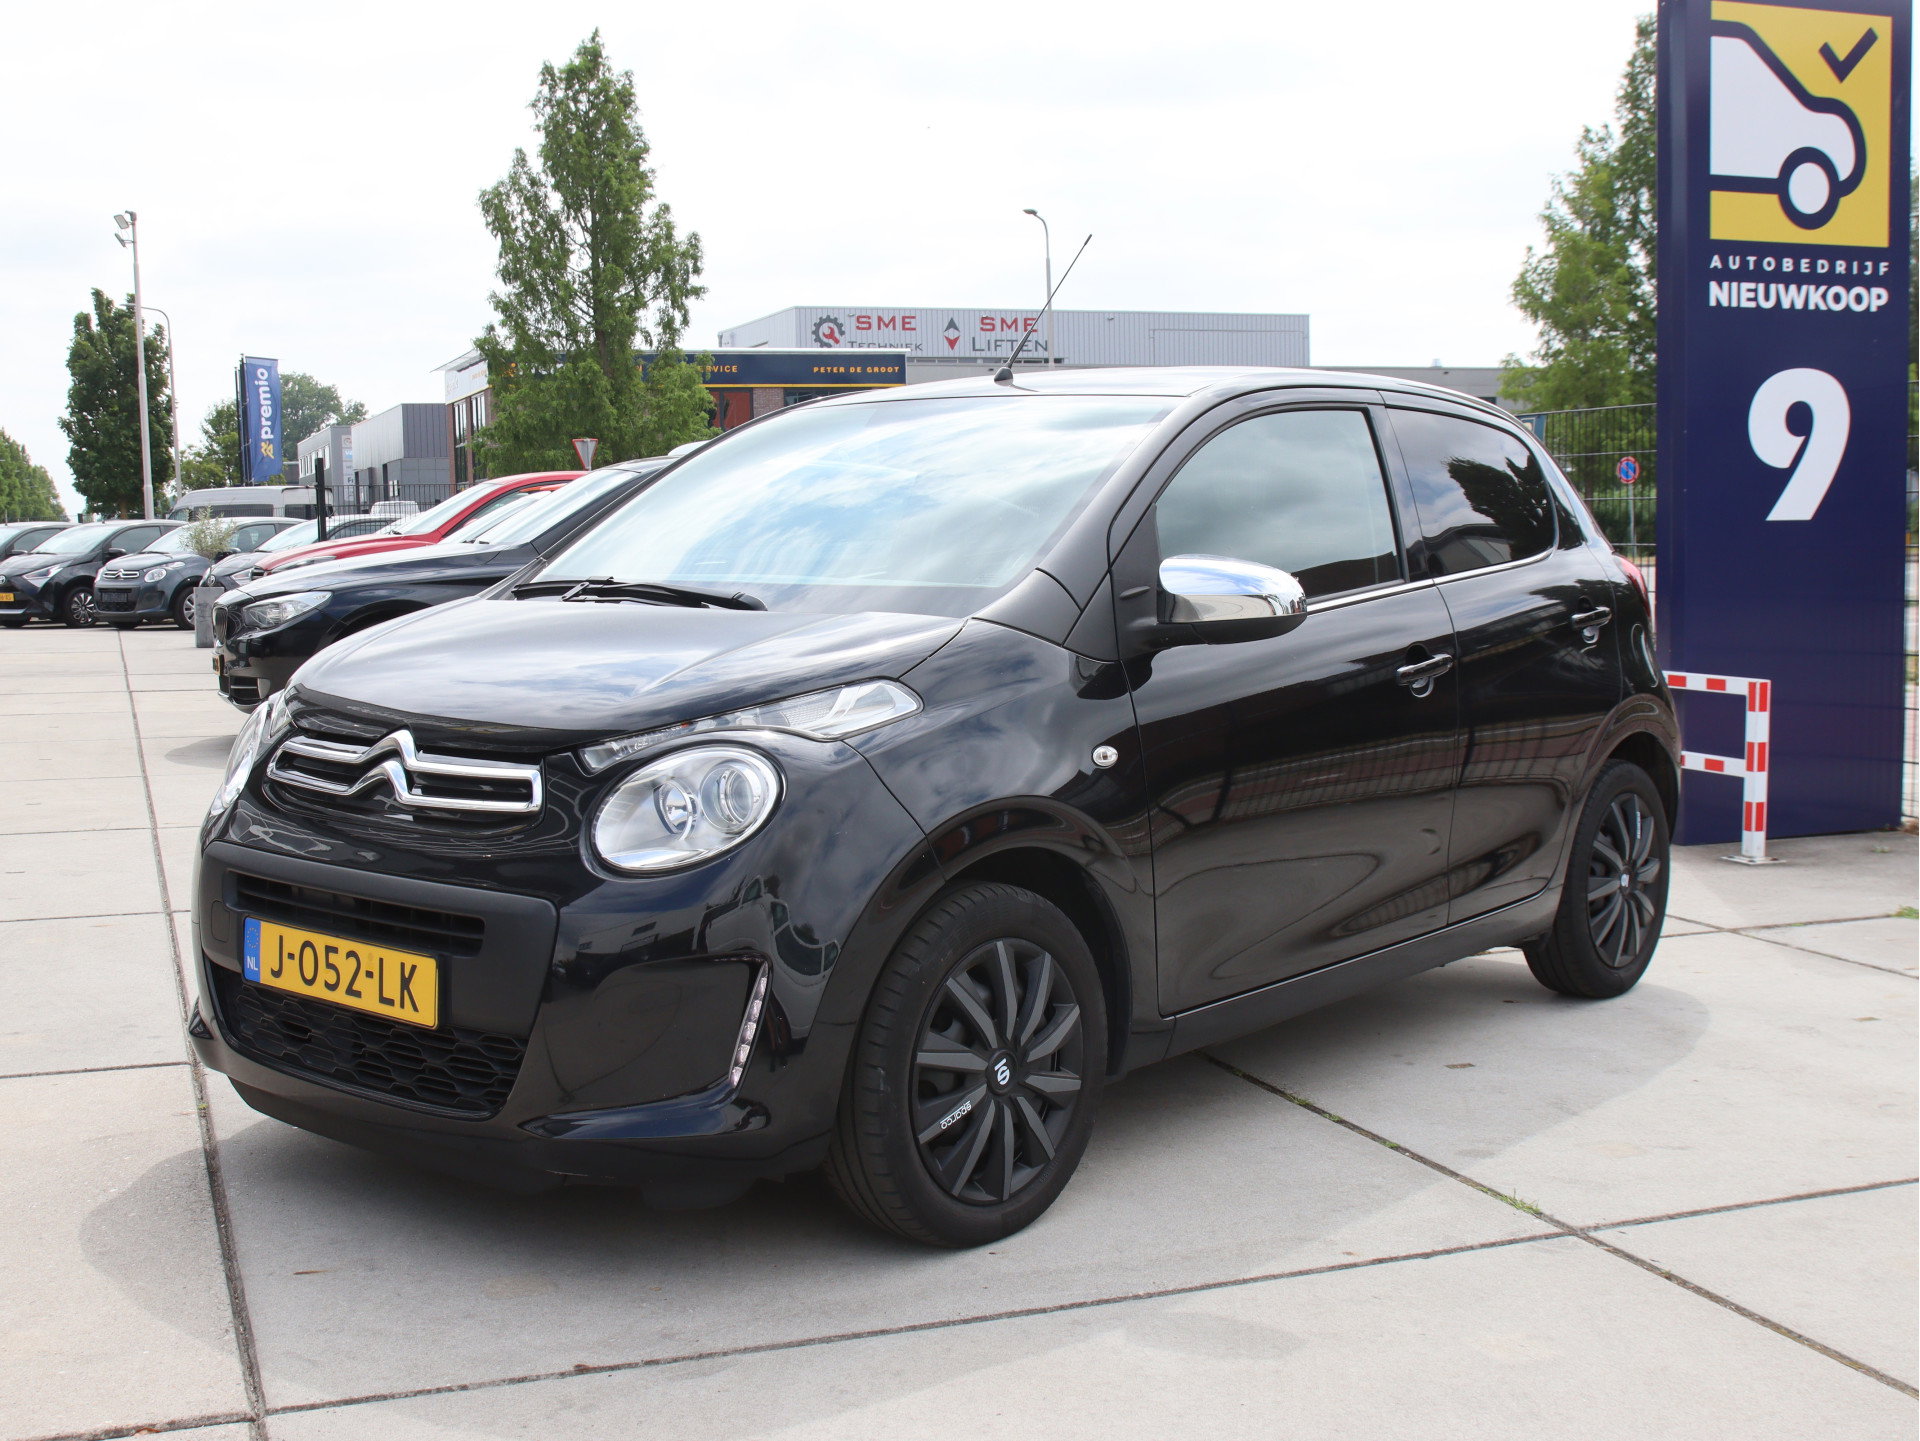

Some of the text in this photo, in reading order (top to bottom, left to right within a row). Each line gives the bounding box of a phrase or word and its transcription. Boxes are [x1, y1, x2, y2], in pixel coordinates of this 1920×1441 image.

[1709, 254, 1890, 276] AUTOBEDRIJF
[1708, 281, 1889, 312] NIEUWKOOP
[855, 315, 917, 331] SME
[979, 316, 1039, 332] SME
[254, 368, 275, 440] premio
[1748, 367, 1851, 522] 9
[247, 956, 258, 971] NL
[270, 935, 420, 1013] J-052-LK
[939, 1100, 972, 1130] sparco
